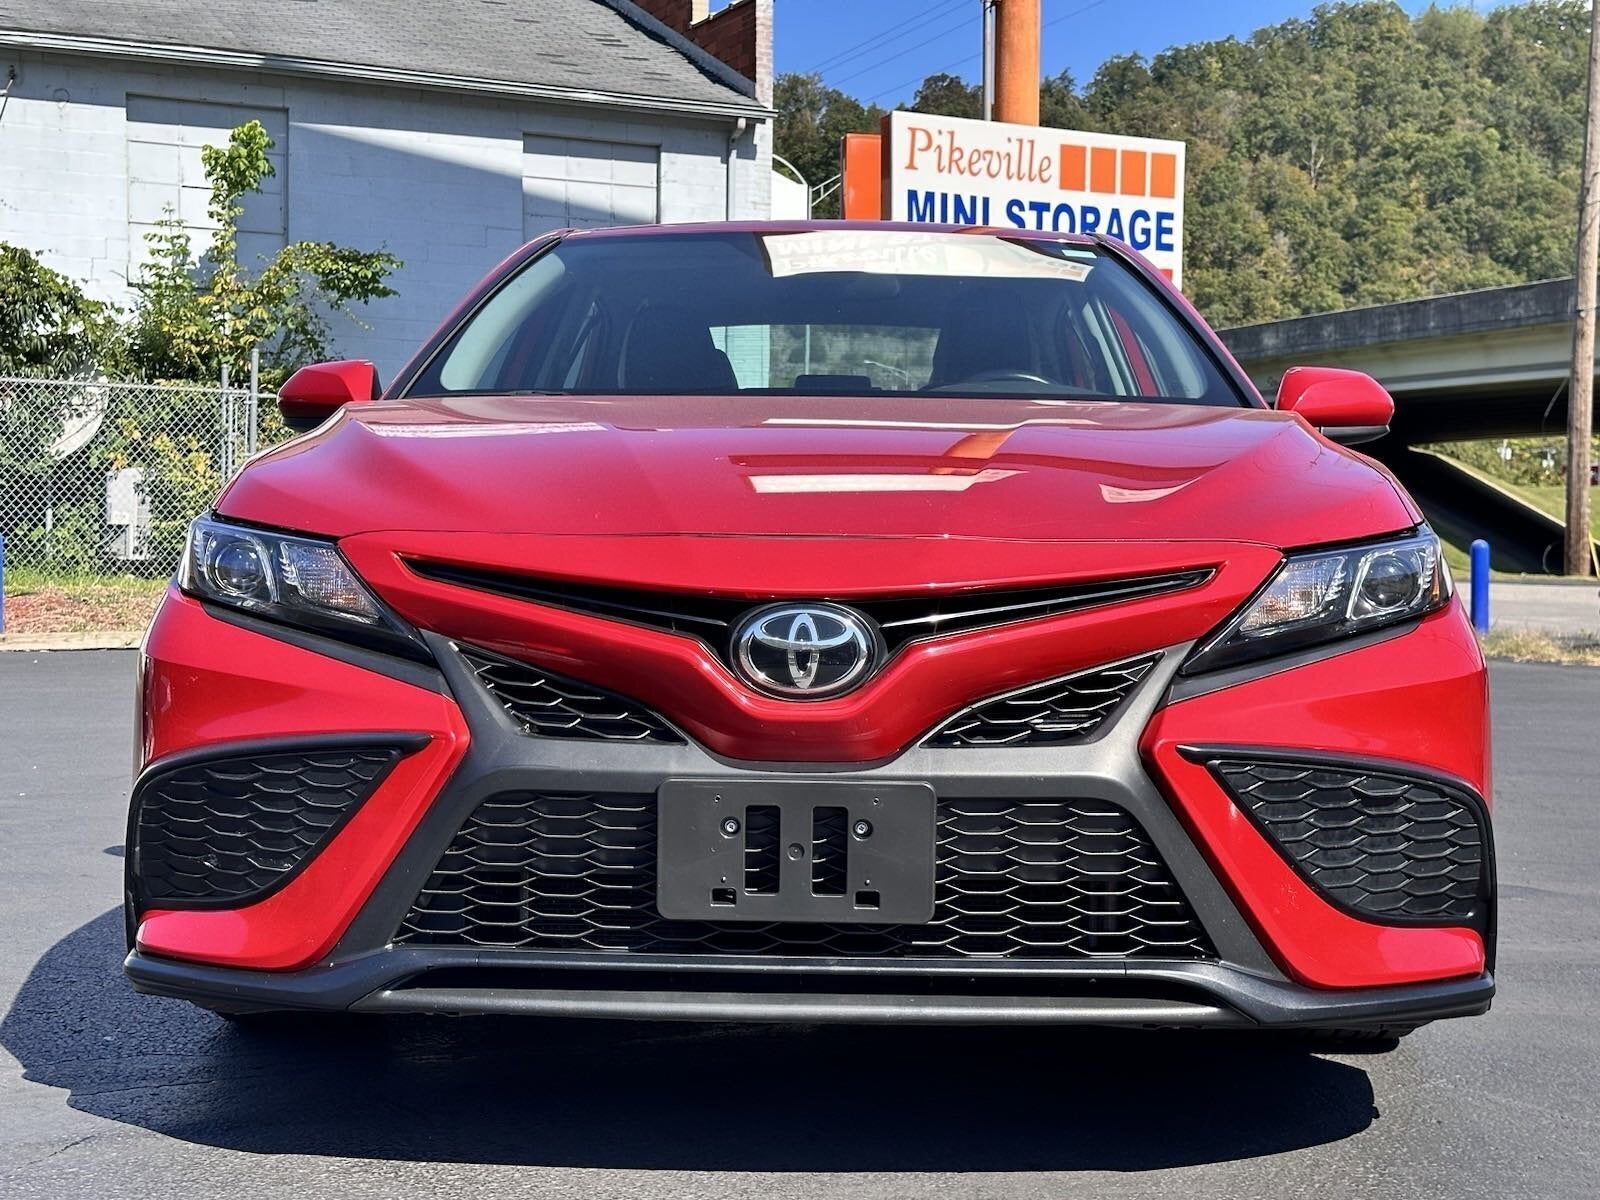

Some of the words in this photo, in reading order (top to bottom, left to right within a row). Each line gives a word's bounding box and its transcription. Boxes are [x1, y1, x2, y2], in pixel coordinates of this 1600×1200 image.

[904, 127, 1052, 184] Pikeville
[907, 189, 990, 226] MINI
[1006, 199, 1174, 252] STORAGE
